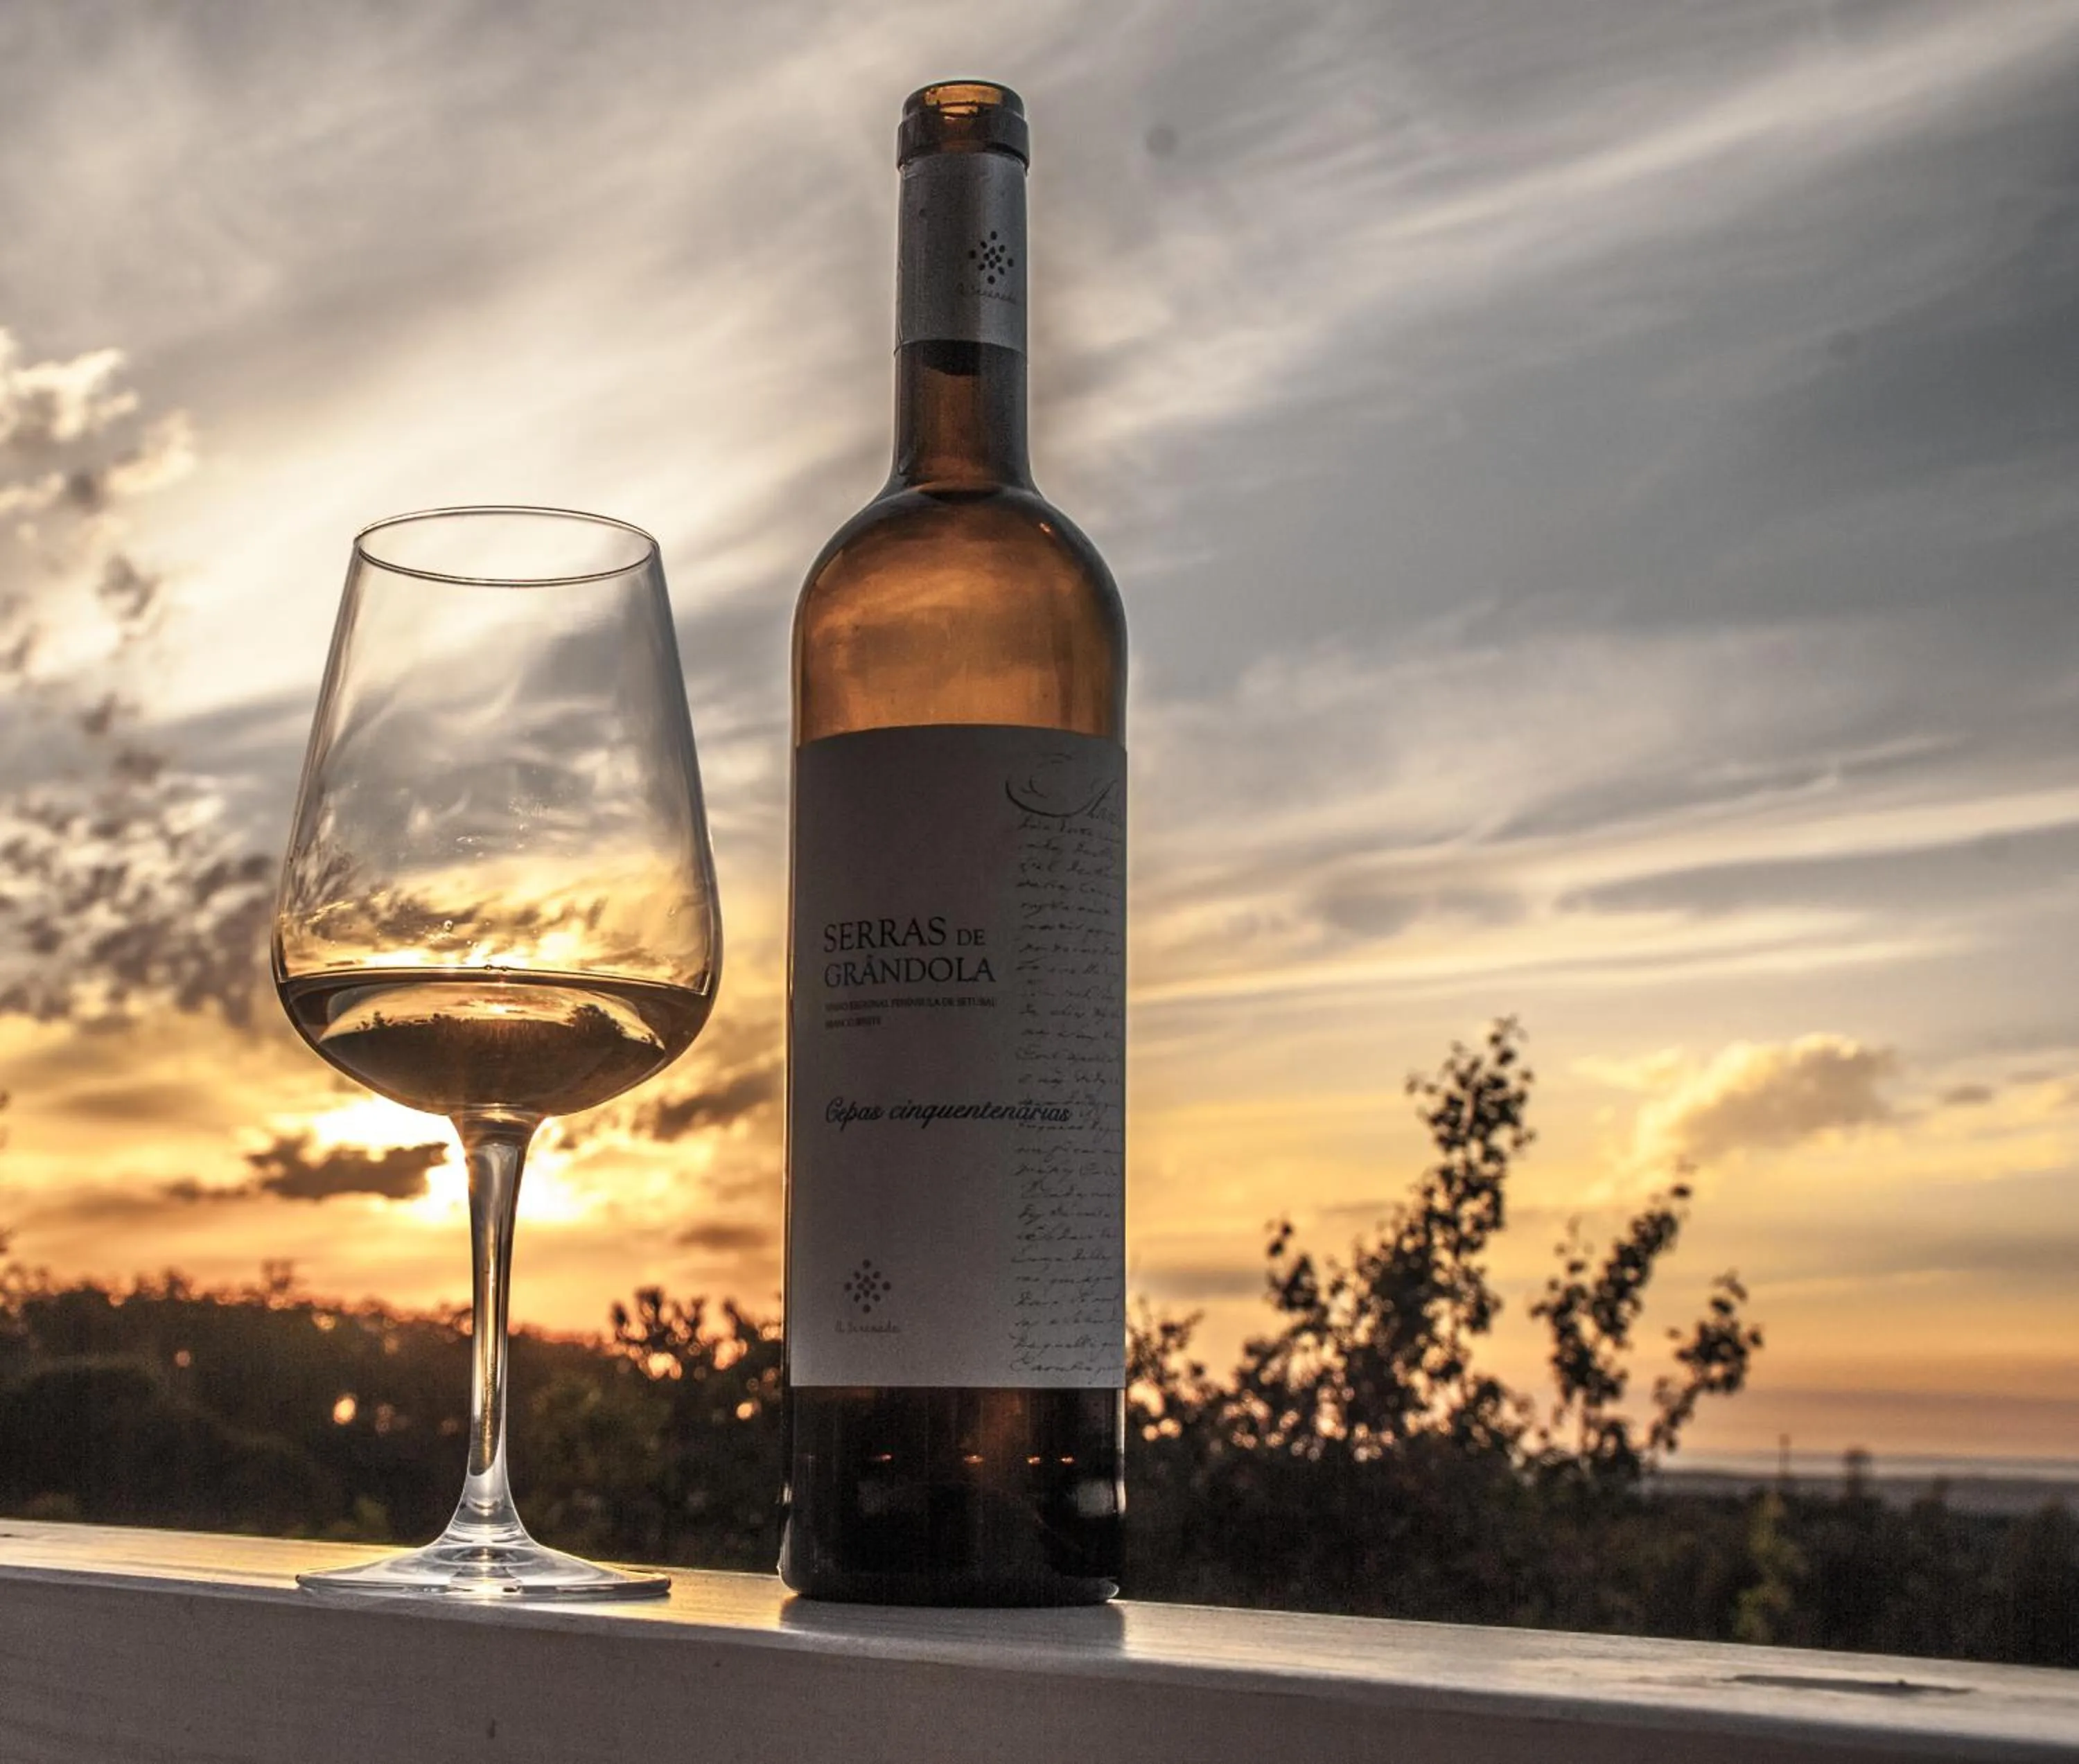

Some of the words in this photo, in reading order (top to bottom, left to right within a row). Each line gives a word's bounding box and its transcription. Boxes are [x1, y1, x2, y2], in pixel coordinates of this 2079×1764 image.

[823, 916, 947, 953] SERRAS
[956, 928, 986, 946] DE
[823, 954, 997, 988] GRÂNDOLA
[825, 1095, 884, 1132] Cepas
